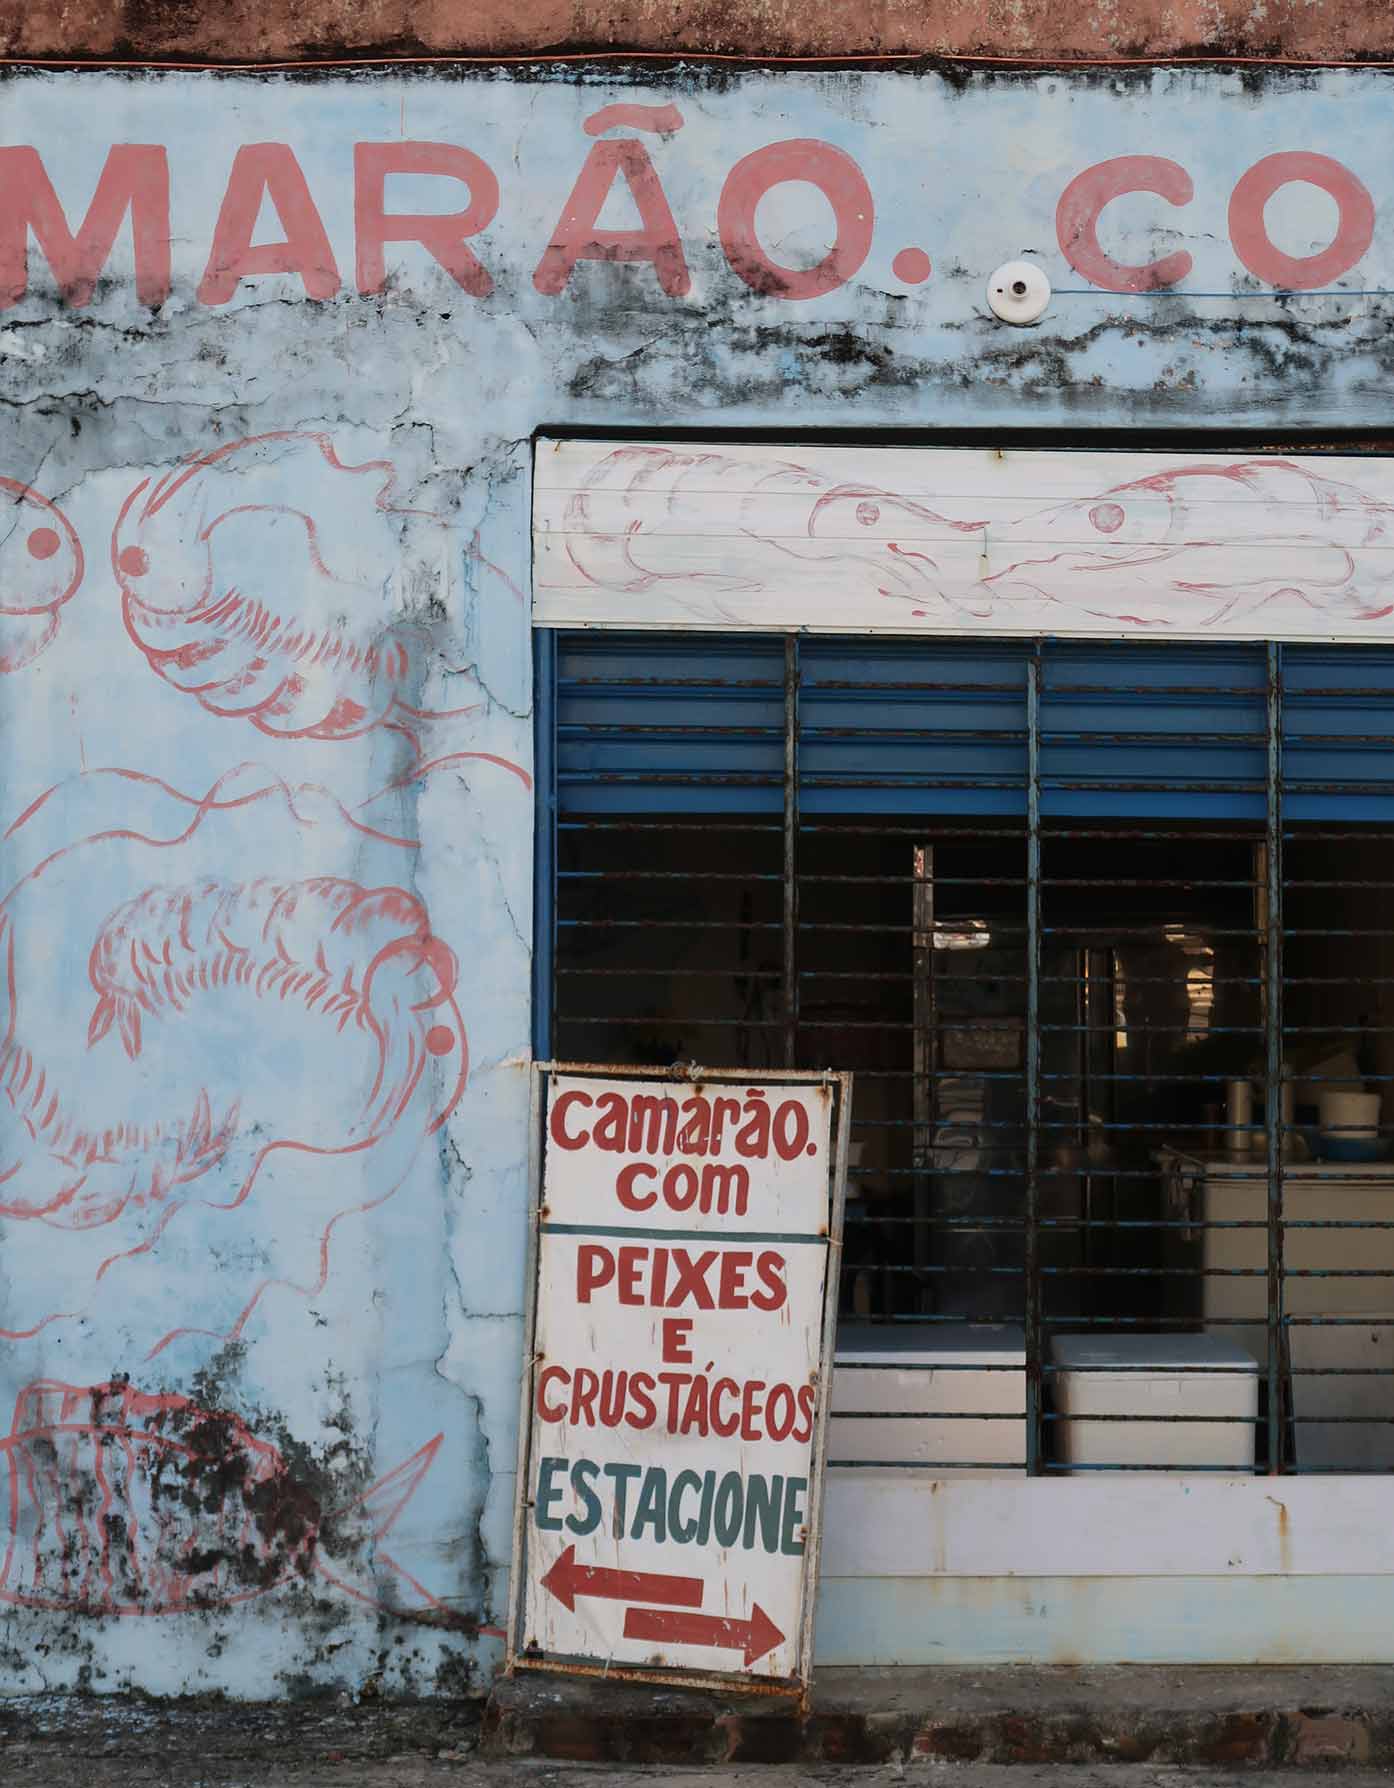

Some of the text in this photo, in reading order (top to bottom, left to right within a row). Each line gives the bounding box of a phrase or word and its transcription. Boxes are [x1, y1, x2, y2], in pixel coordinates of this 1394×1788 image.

[0, 104, 1375, 306] MARÃO. CO
[576, 1244, 787, 1312] PEIXES
[662, 1318, 693, 1363] E
[537, 1361, 815, 1443] CRUSTÁCEOS
[535, 1457, 808, 1556] ESTACIONE
